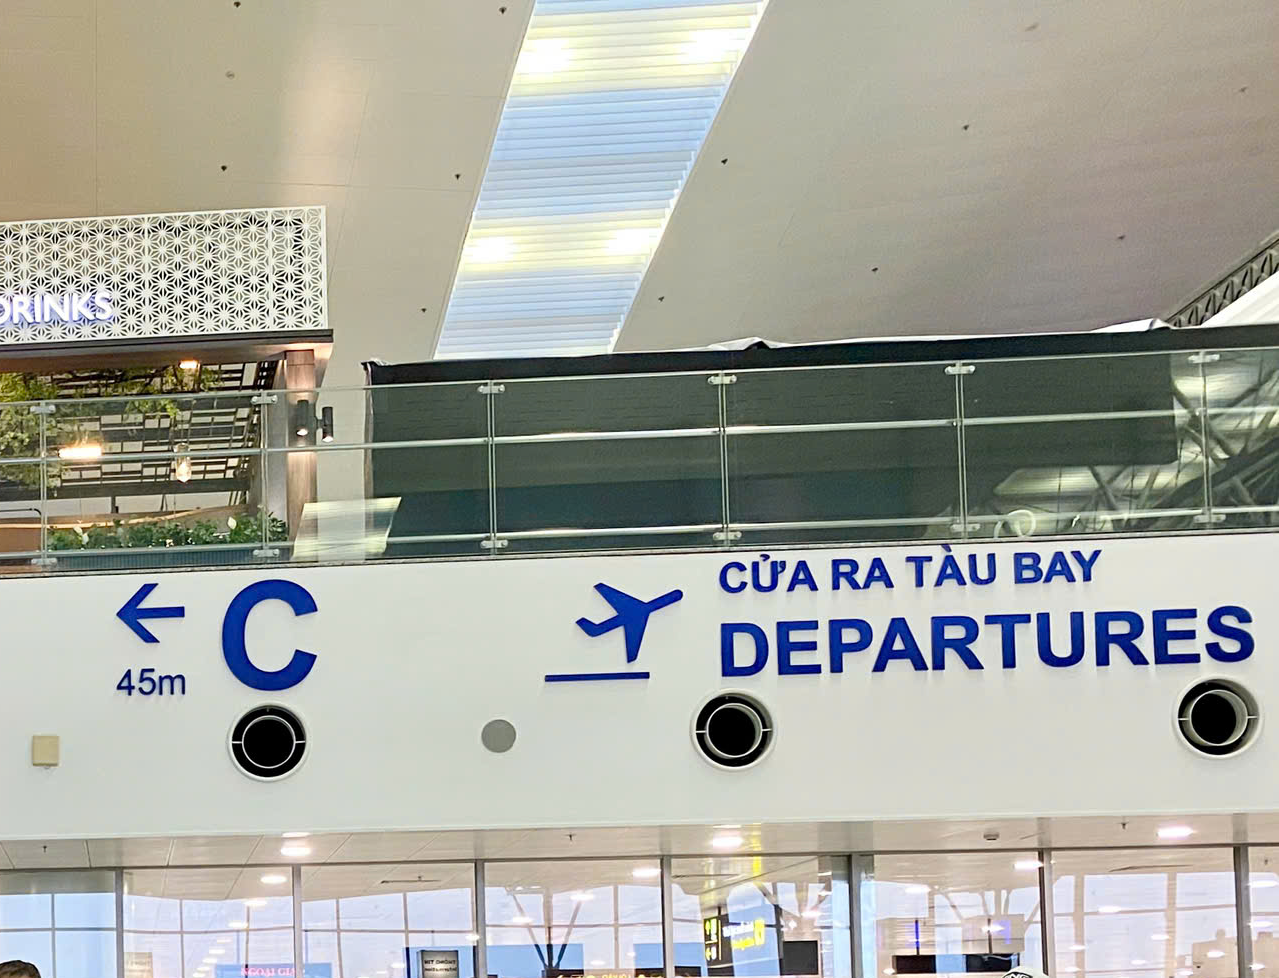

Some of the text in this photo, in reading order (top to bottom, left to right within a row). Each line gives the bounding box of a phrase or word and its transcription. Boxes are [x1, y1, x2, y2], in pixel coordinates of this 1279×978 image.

[719, 545, 1103, 594] CỬA RA TÀU BAY
[221, 579, 319, 691] C
[719, 604, 1257, 678] DEPARTURES
[115, 668, 186, 697] 45m
